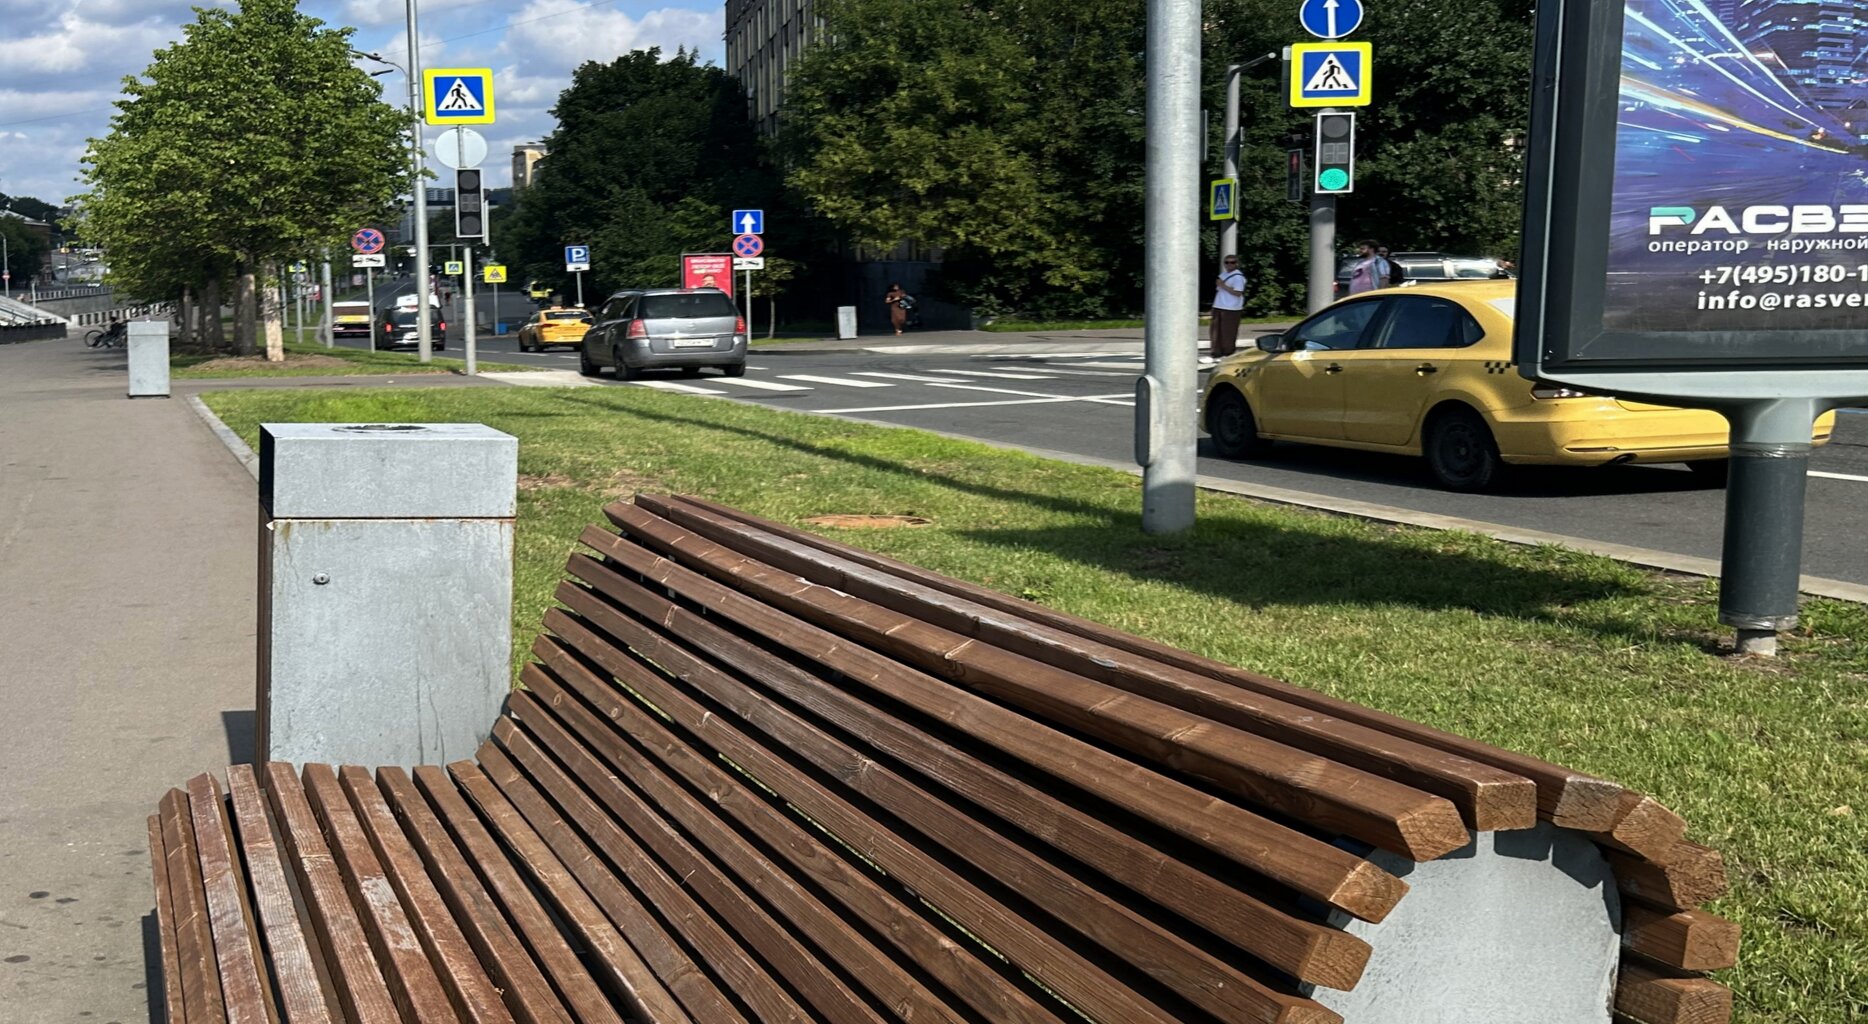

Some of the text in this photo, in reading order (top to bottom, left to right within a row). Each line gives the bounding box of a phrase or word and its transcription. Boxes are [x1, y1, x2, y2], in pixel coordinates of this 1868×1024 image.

[1648, 235, 1868, 255] оператор наружной
[1698, 264, 1868, 286] +7(495)180-1
